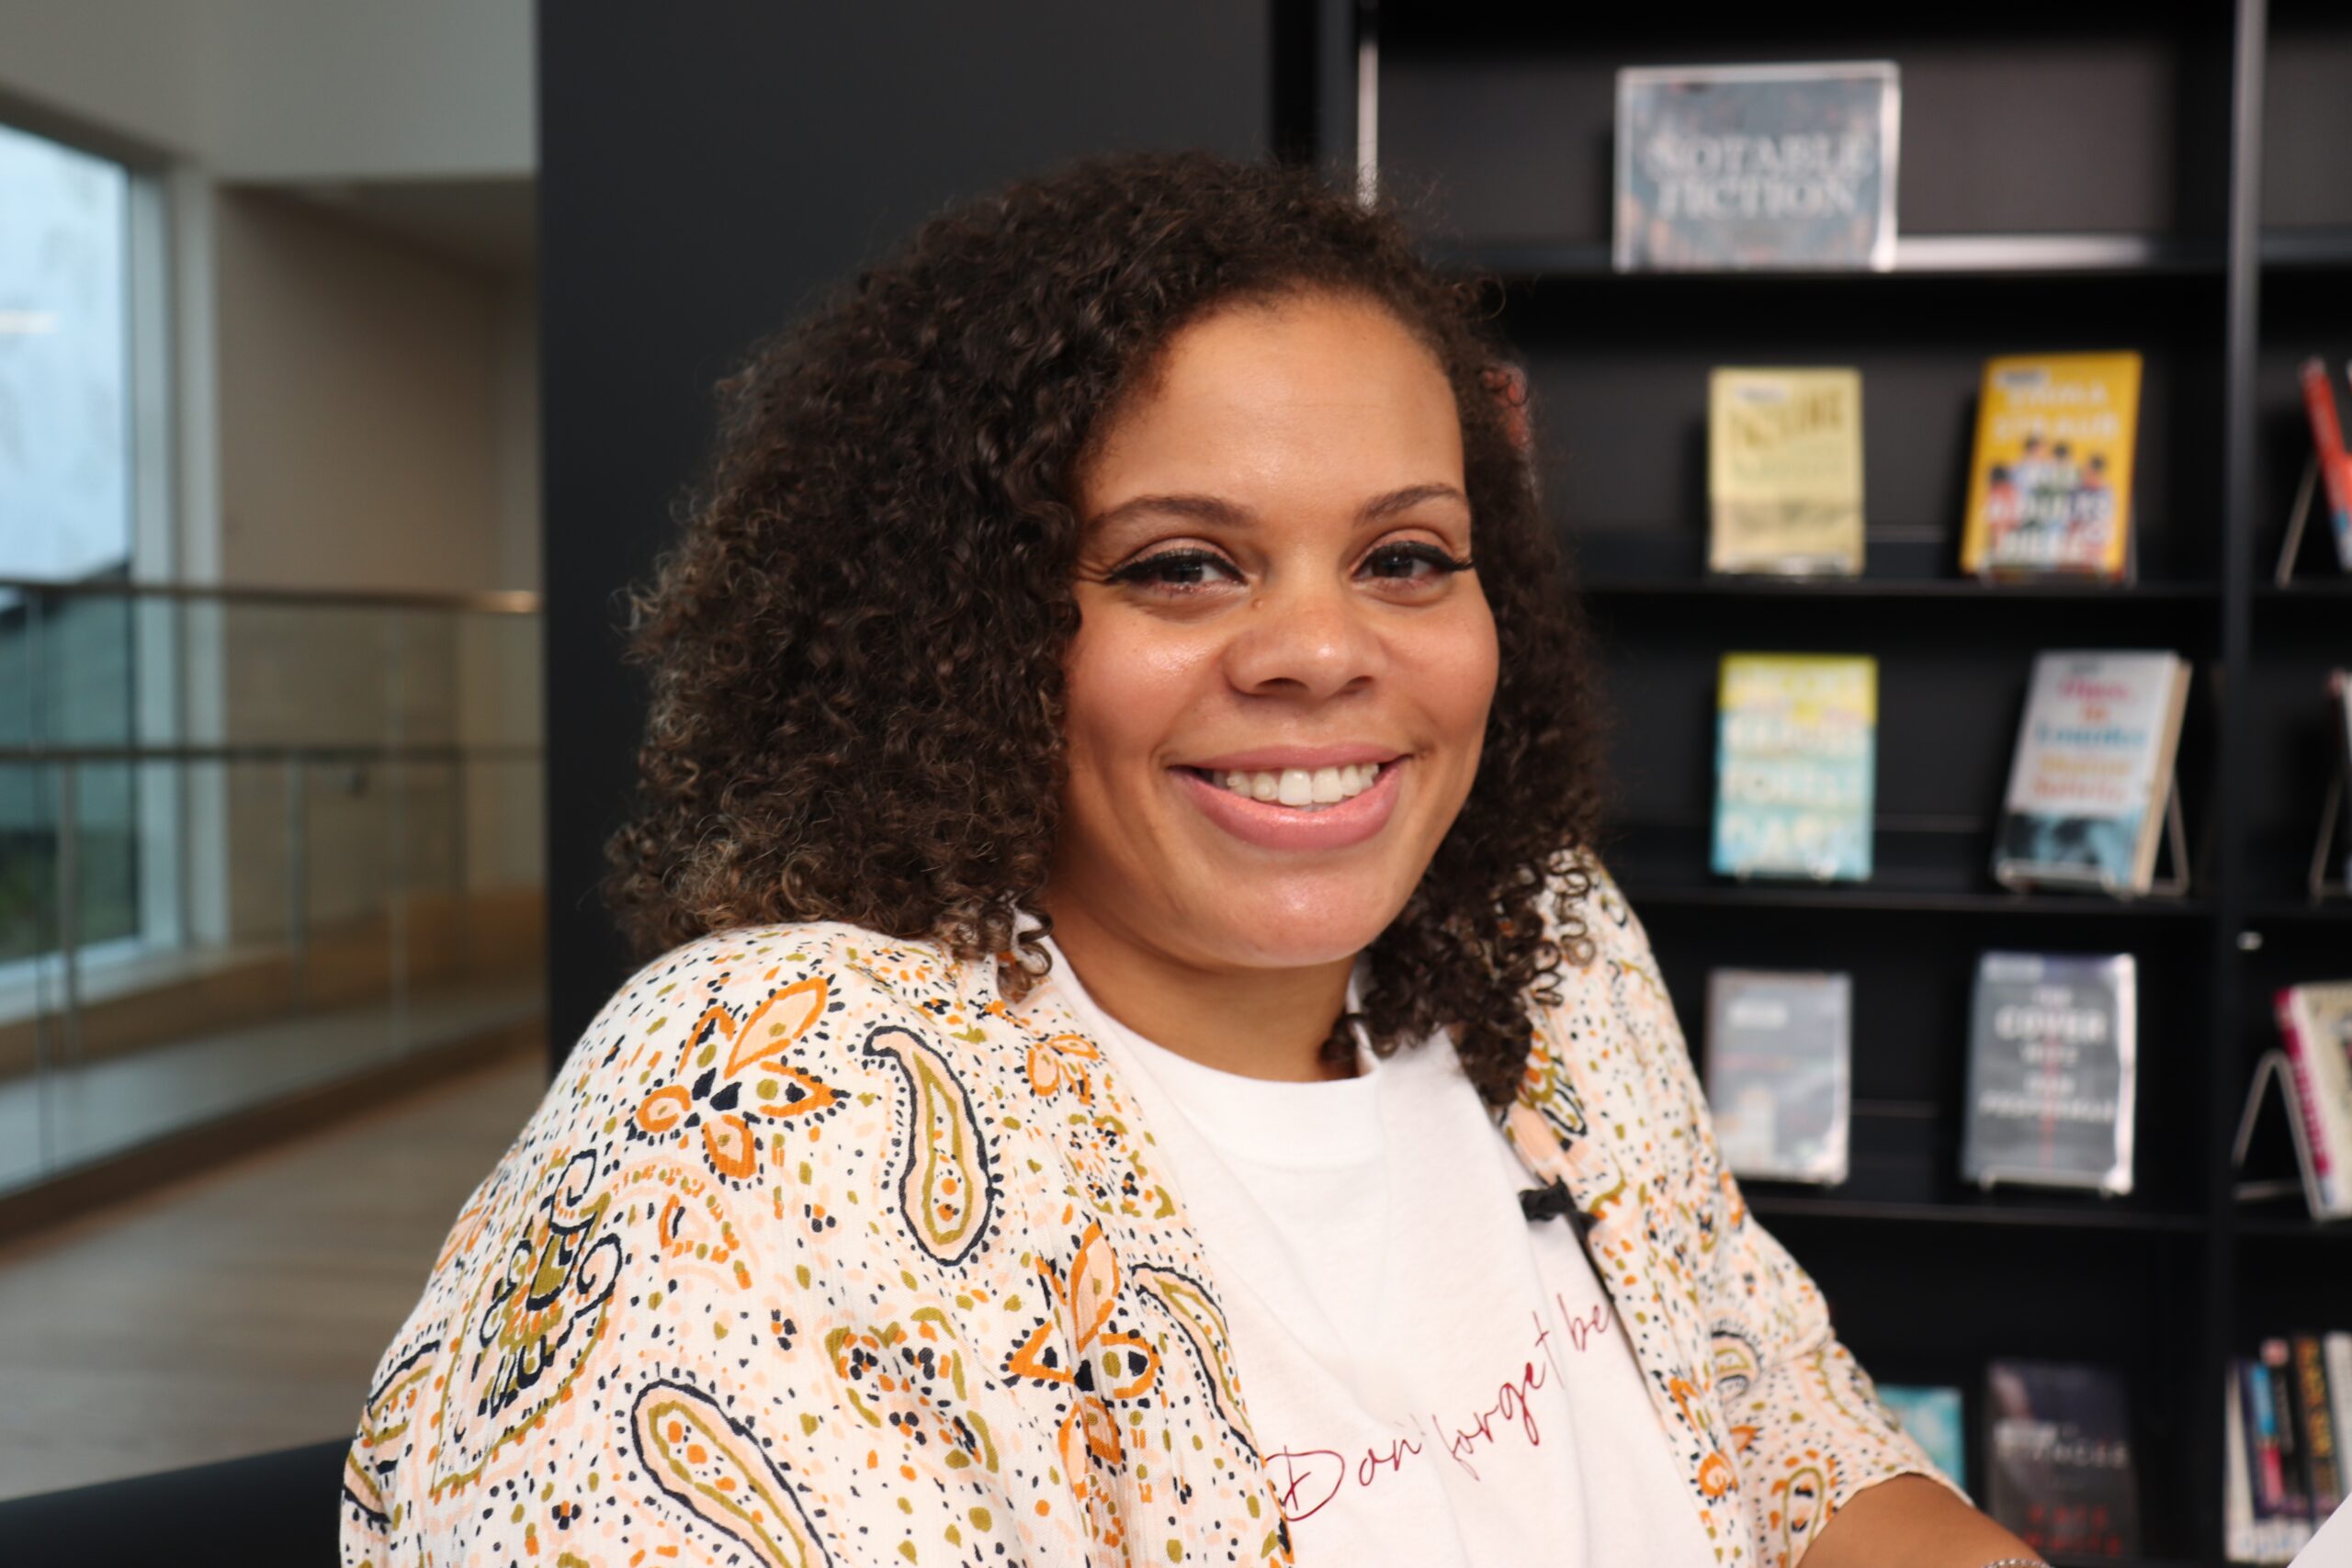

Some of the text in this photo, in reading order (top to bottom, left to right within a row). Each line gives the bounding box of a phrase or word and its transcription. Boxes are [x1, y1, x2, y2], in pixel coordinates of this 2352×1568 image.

[1645, 133, 1871, 180] NOTABLE
[1658, 178, 1857, 219] FICTION
[1997, 1009, 2106, 1043] COVER
[1430, 1310, 1565, 1482] forget
[1556, 1292, 1611, 1352] be
